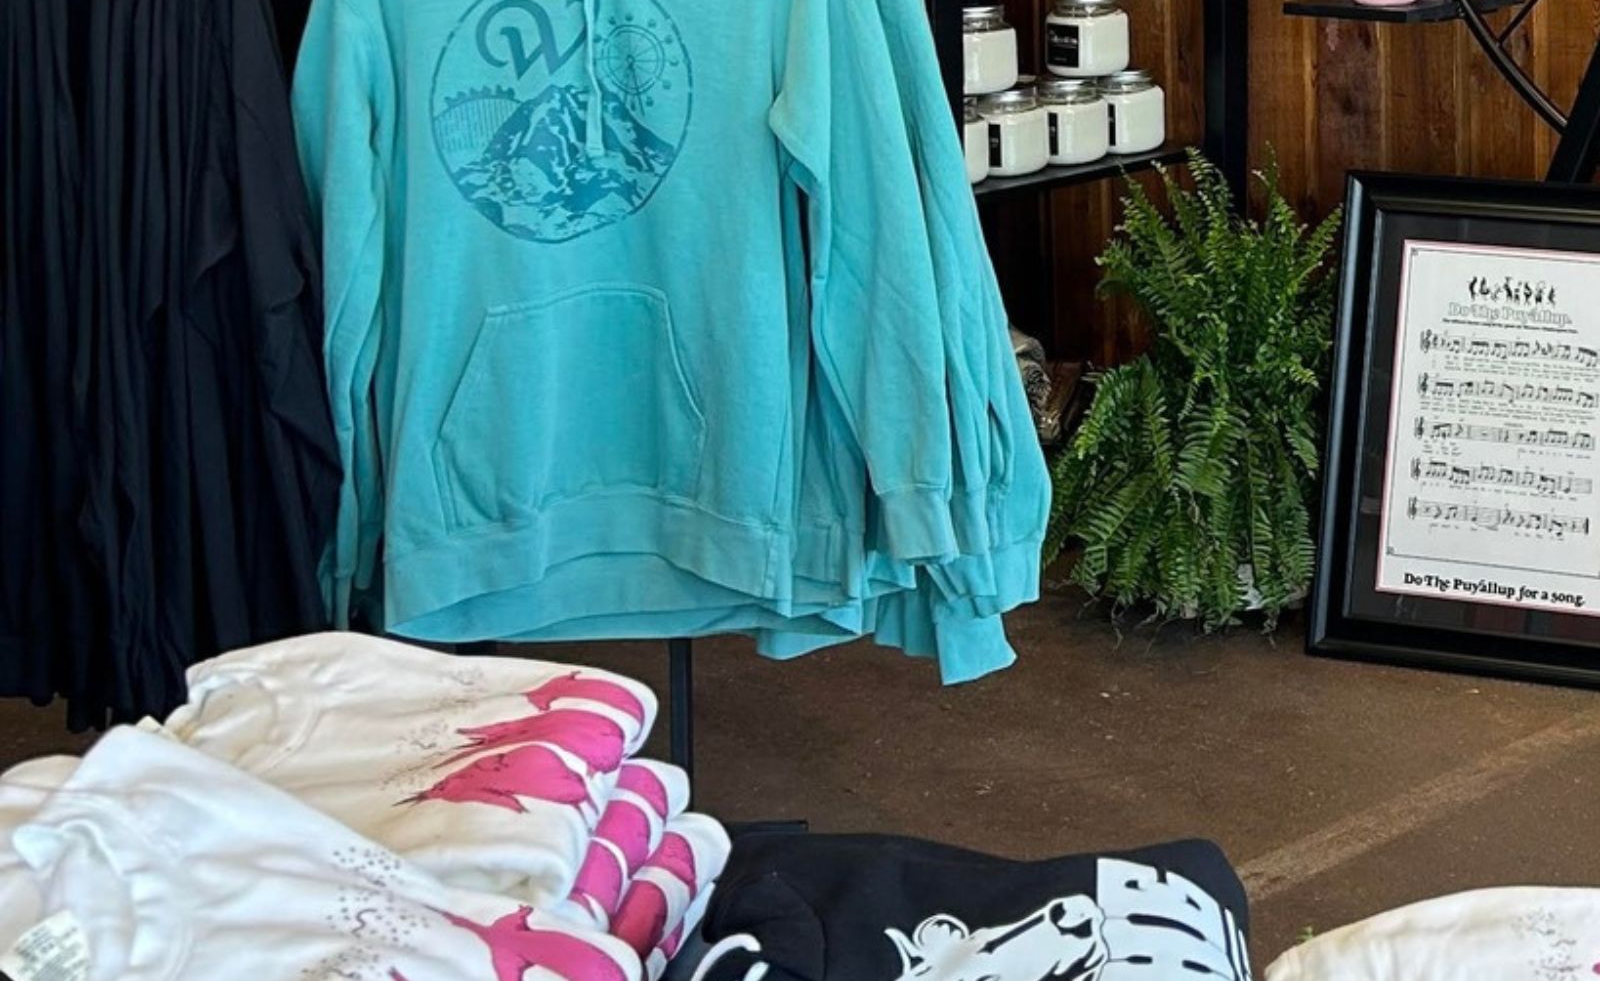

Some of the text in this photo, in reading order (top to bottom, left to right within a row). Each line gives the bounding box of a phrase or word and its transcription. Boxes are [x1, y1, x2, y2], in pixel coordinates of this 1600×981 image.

[1404, 572, 1422, 586] Do
[1424, 575, 1450, 592] The
[1518, 585, 1538, 601] for
[1541, 591, 1548, 600] a
